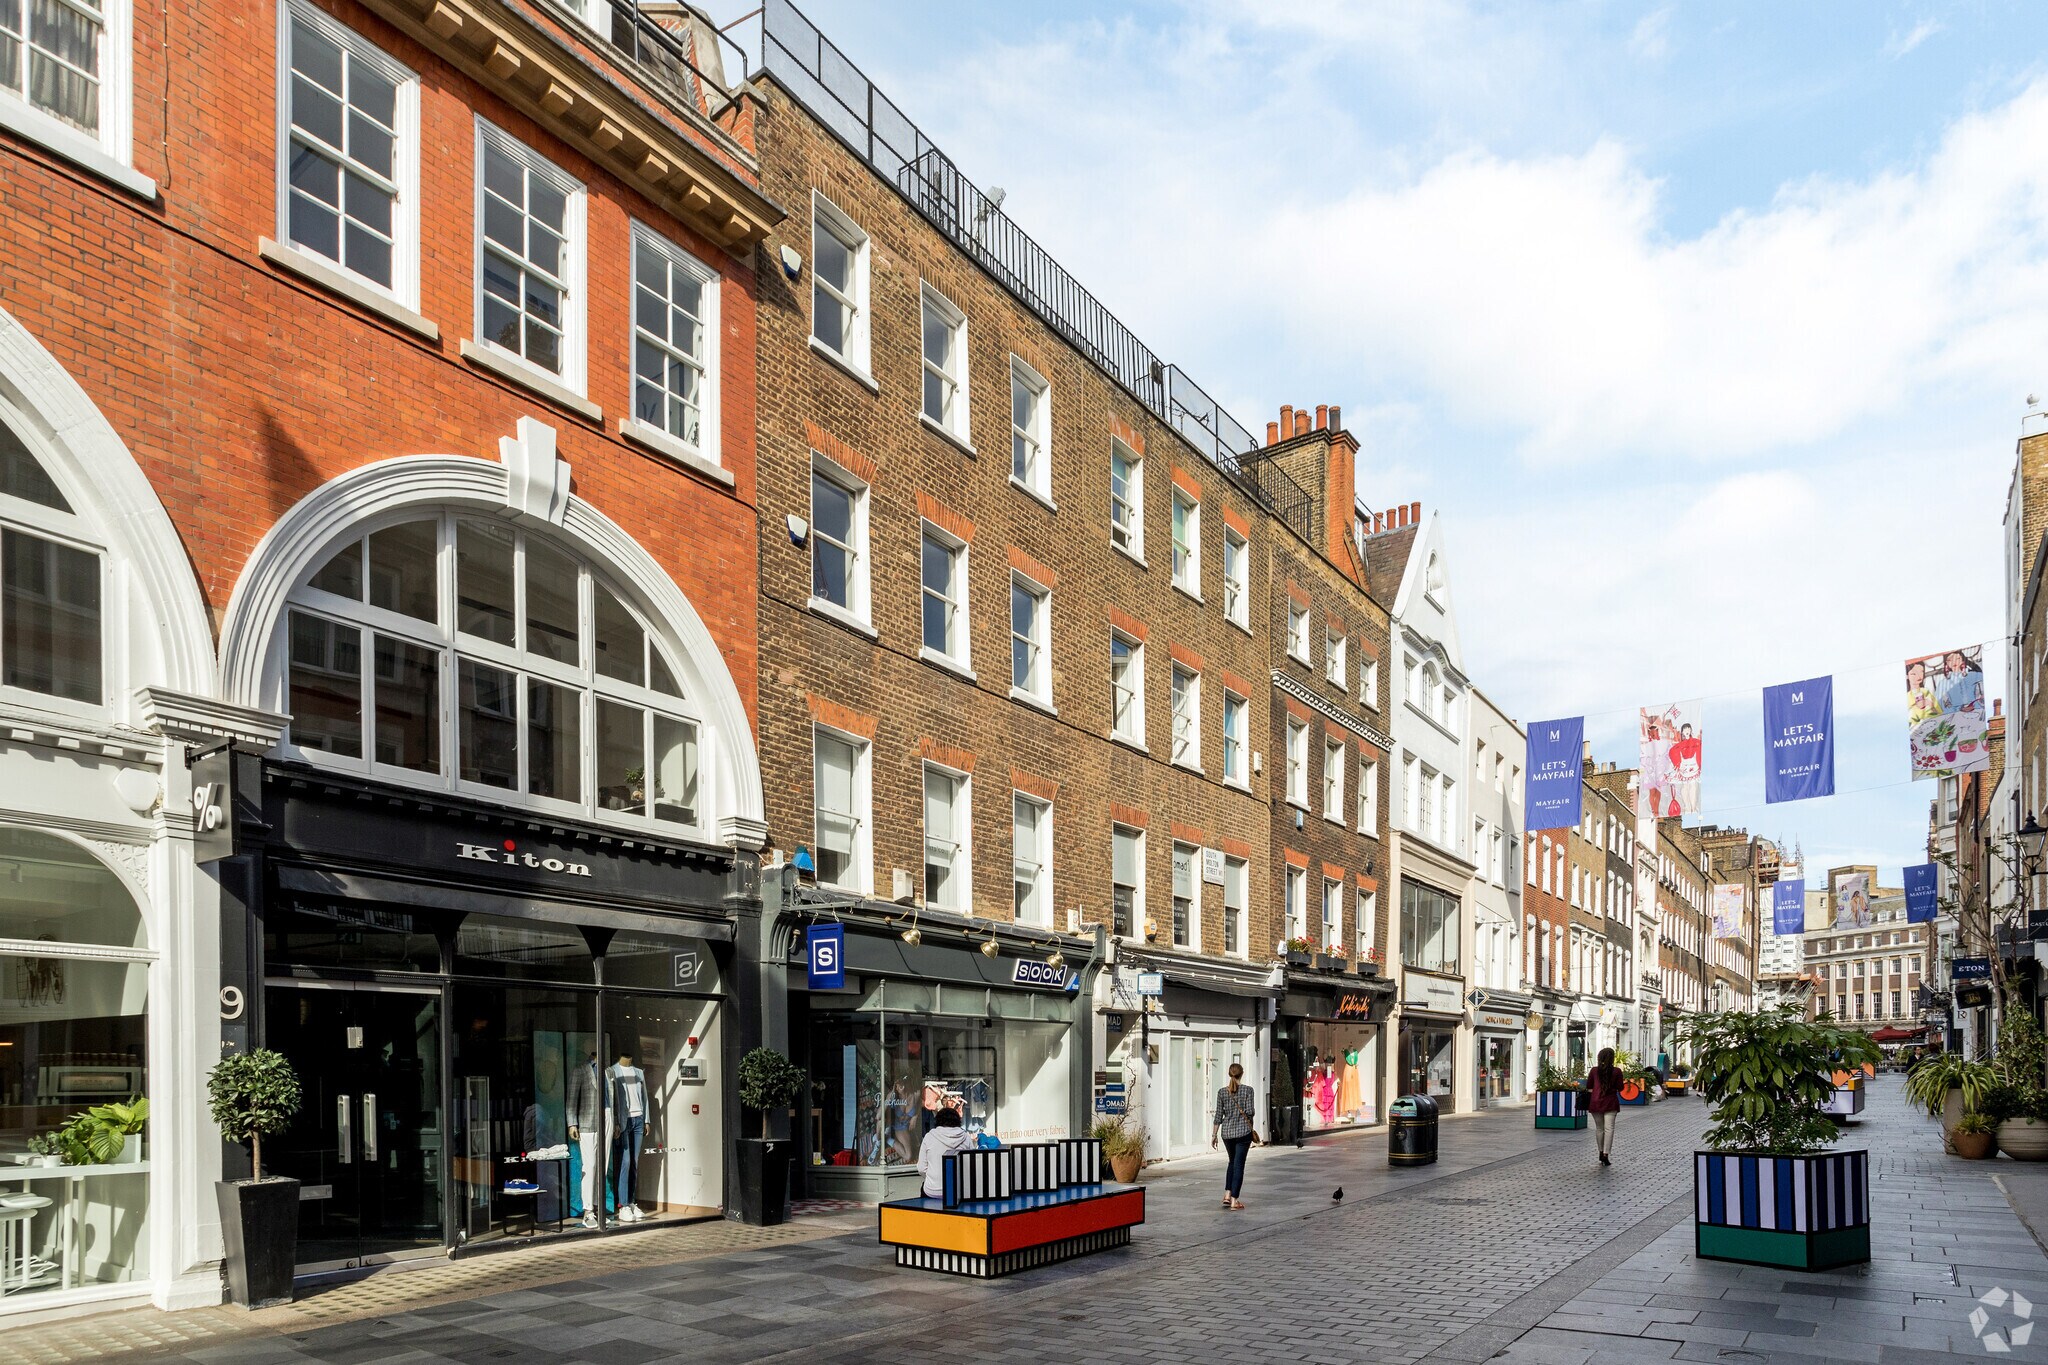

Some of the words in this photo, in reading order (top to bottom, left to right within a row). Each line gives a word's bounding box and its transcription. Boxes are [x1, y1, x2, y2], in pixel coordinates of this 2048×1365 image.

[1791, 691, 1804, 703] M
[1549, 730, 1560, 740] M
[1784, 723, 1814, 736] LET'S
[1773, 733, 1824, 748] MAYFAIR
[1541, 761, 1567, 771] LET'S
[1779, 764, 1820, 775] MAYFAIR
[1532, 770, 1575, 781] MAYFAIR
[1535, 798, 1570, 807] MAYFAIR
[456, 839, 592, 877] Kiton
[1206, 867, 1218, 876] STREET
[818, 947, 833, 967] S
[1019, 964, 1064, 981] SOOK
[1010, 1128, 1023, 1138] into
[1035, 1128, 1048, 1138] very
[1049, 1125, 1066, 1135] fabric
[645, 1143, 685, 1155] Kiton
